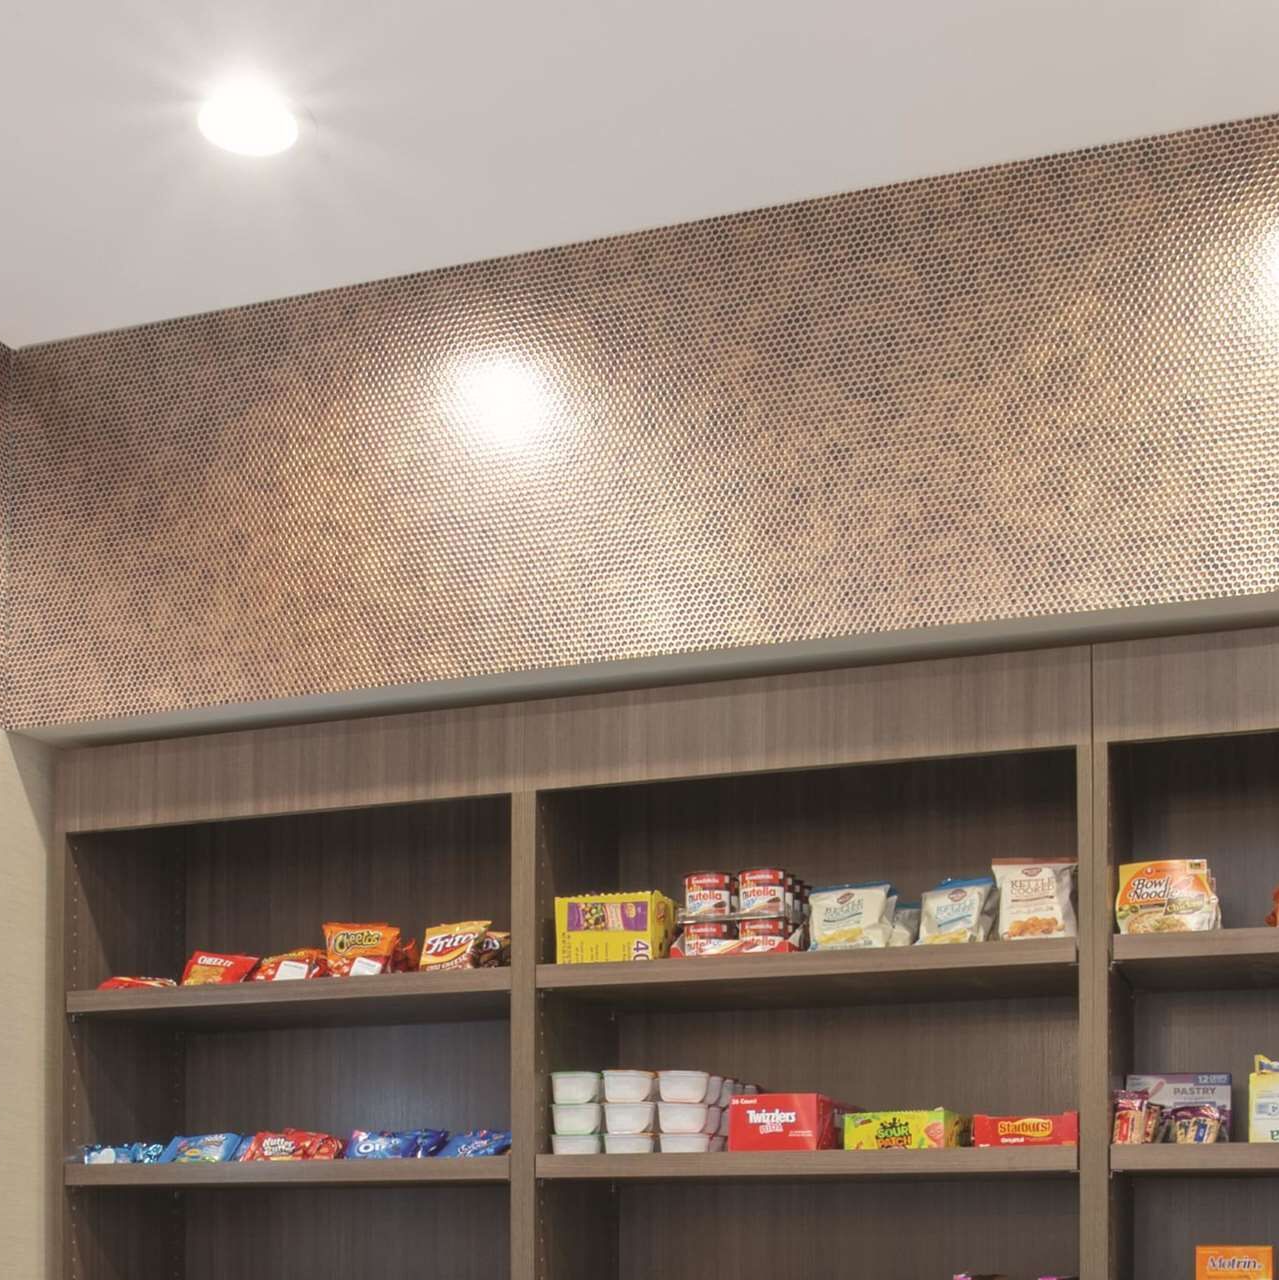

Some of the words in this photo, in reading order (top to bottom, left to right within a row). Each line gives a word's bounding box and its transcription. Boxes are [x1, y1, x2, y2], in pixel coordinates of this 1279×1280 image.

[1135, 876, 1170, 890] Bowl
[687, 891, 722, 903] nutella
[741, 887, 777, 899] nutella
[333, 931, 382, 954] Cheetos
[1173, 1086, 1217, 1096] PASTRY
[746, 1108, 797, 1124] Twizzlers
[877, 1125, 910, 1138] SOUR
[1207, 1256, 1258, 1270] Motrin
